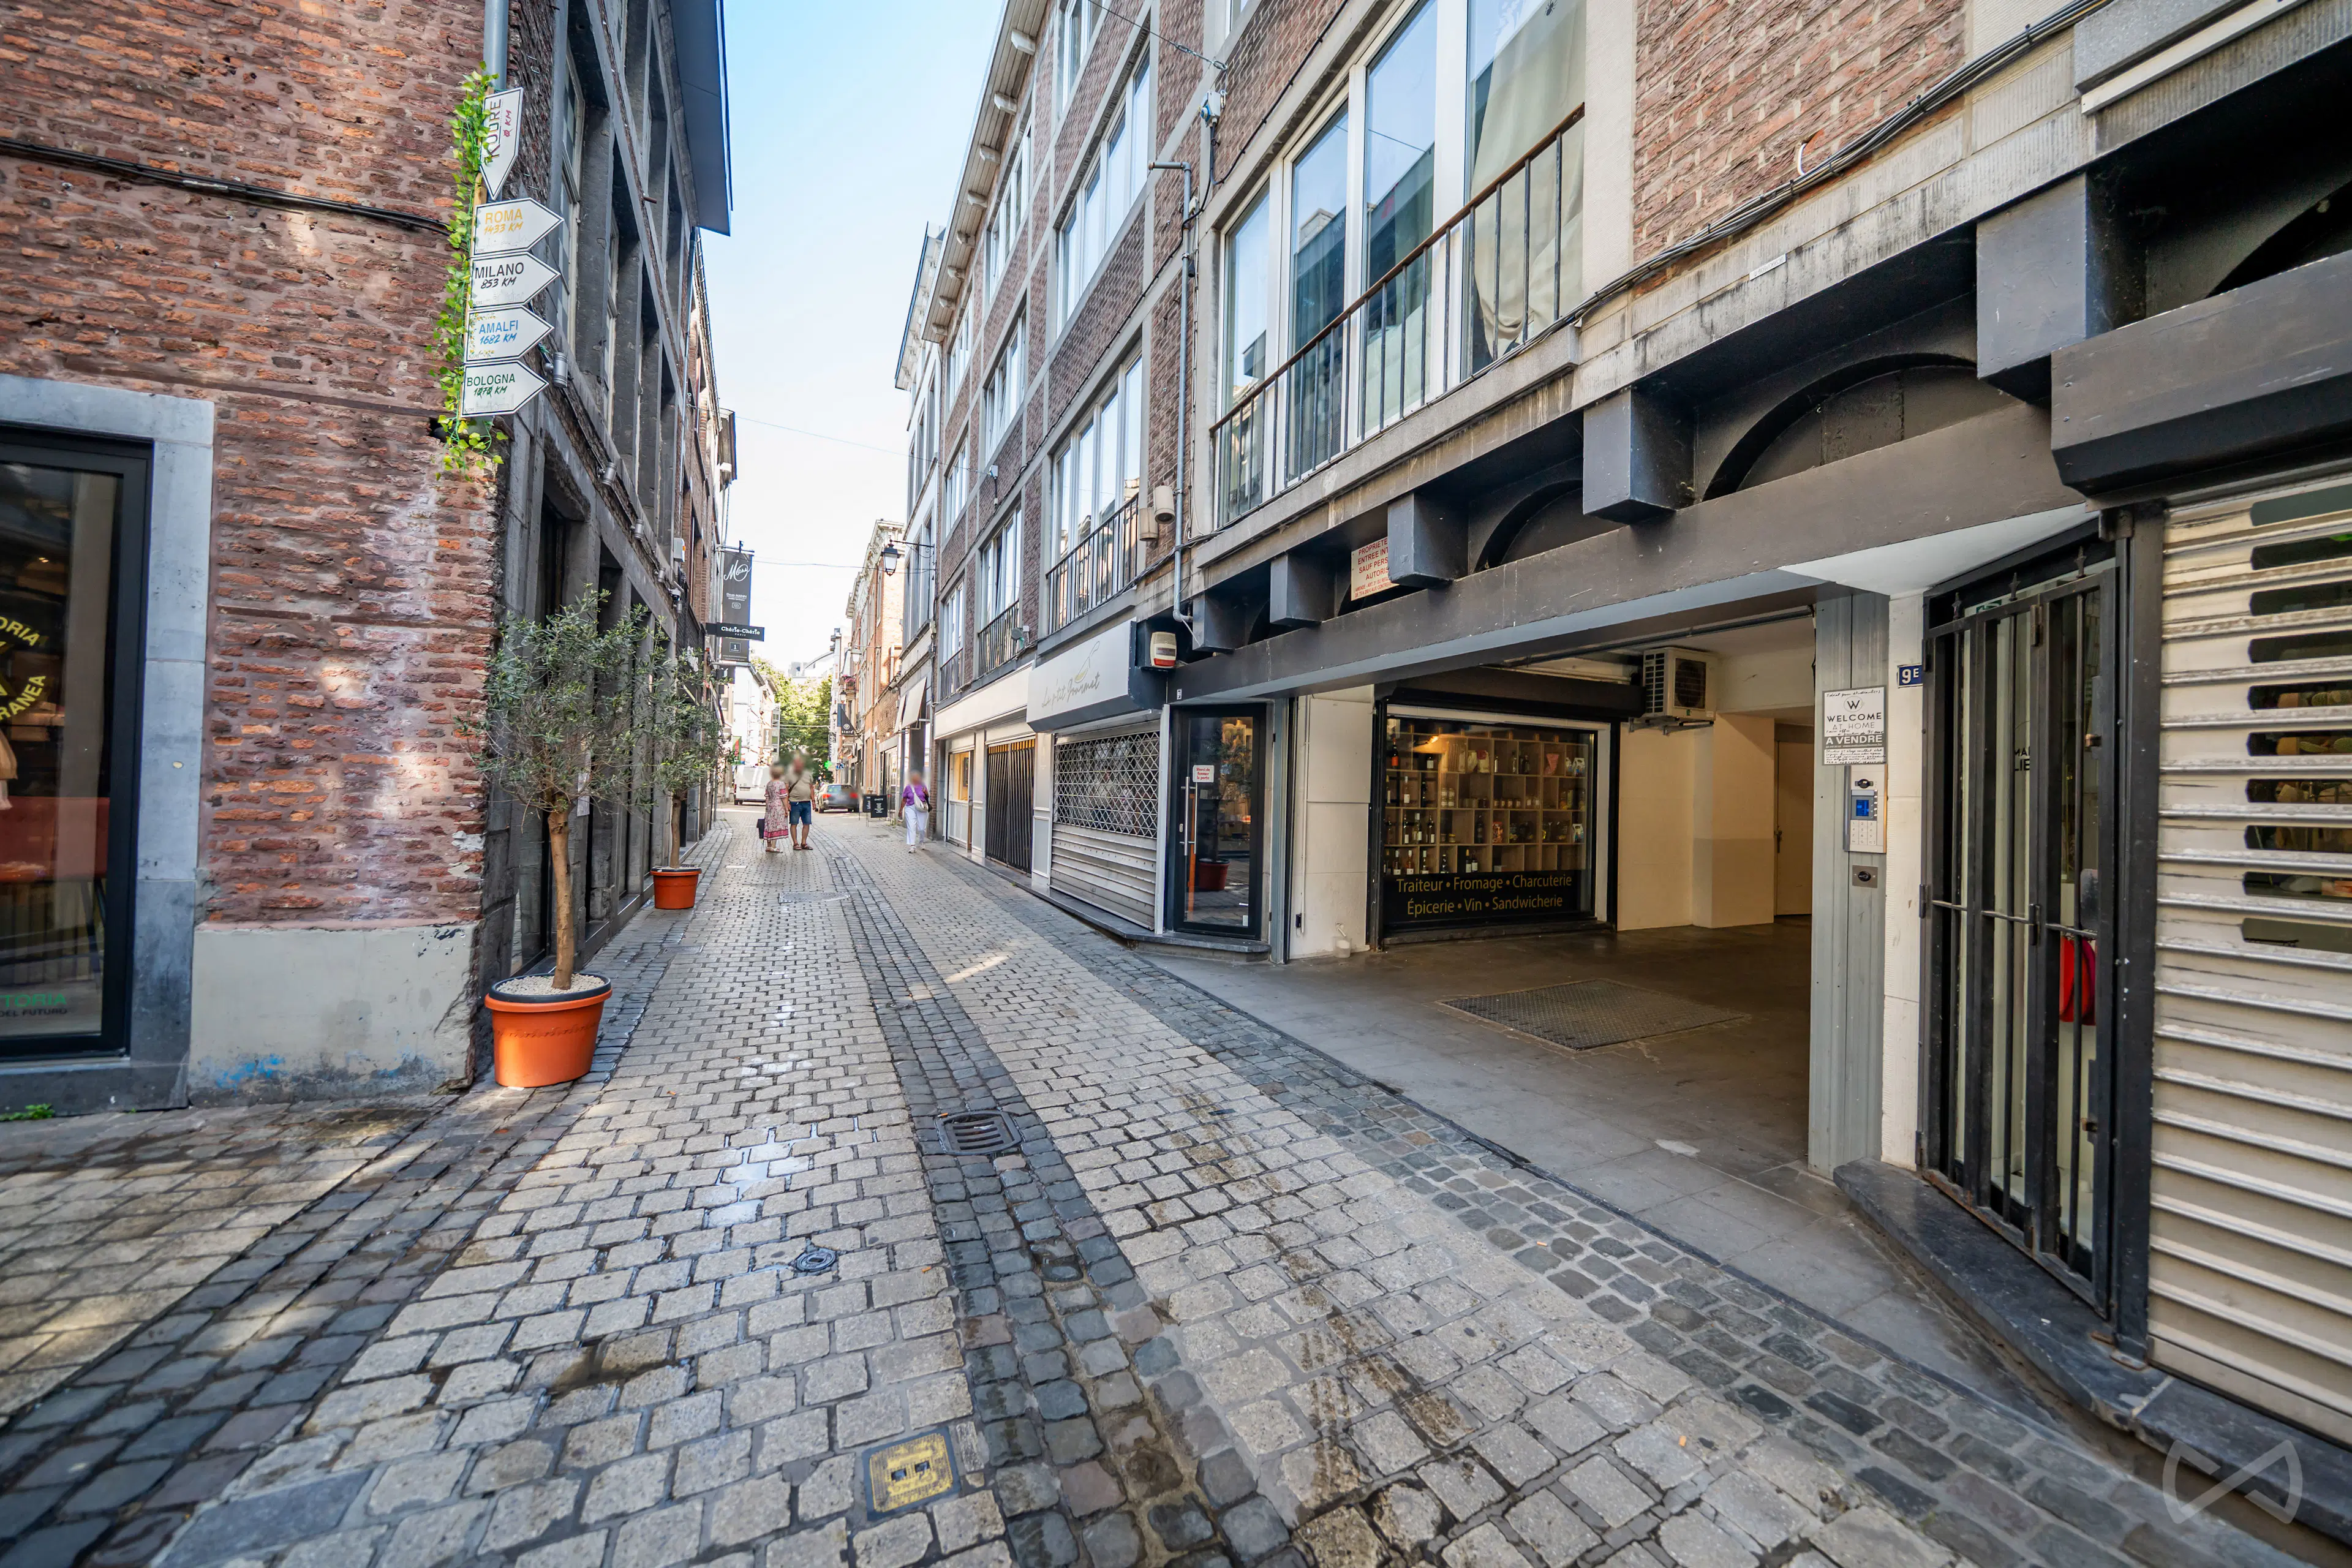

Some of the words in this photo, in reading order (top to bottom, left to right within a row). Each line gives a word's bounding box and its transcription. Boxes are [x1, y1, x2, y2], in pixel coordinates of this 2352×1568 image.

[505, 110, 512, 126] KM
[485, 208, 523, 224] ROMA
[484, 223, 506, 235] 1433
[508, 221, 524, 232] KM
[475, 262, 524, 279] MILANO
[481, 279, 499, 289] 853
[502, 276, 517, 287] KM
[479, 320, 519, 334] AMALFI
[480, 334, 501, 344] 1682
[503, 333, 517, 342] KM
[467, 374, 515, 387] BOLOGNA
[494, 386, 508, 394] KM
[1358, 538, 1388, 556] PROPRIETE
[1358, 551, 1379, 565] ENTREE
[1359, 562, 1373, 573] SAUF
[1374, 557, 1389, 568] PERS
[721, 626, 761, 635] Chérie-Chérie
[1827, 712, 1882, 722] WELCOME
[1836, 734, 1883, 745] VENDRE
[1396, 878, 1443, 892] Traiteur
[1453, 877, 1503, 892] Fromage
[1513, 874, 1572, 888] Charcuterie
[1408, 898, 1455, 918] Épicerie
[1464, 898, 1482, 911] Vin
[1492, 894, 1562, 910] Sandwicherie
